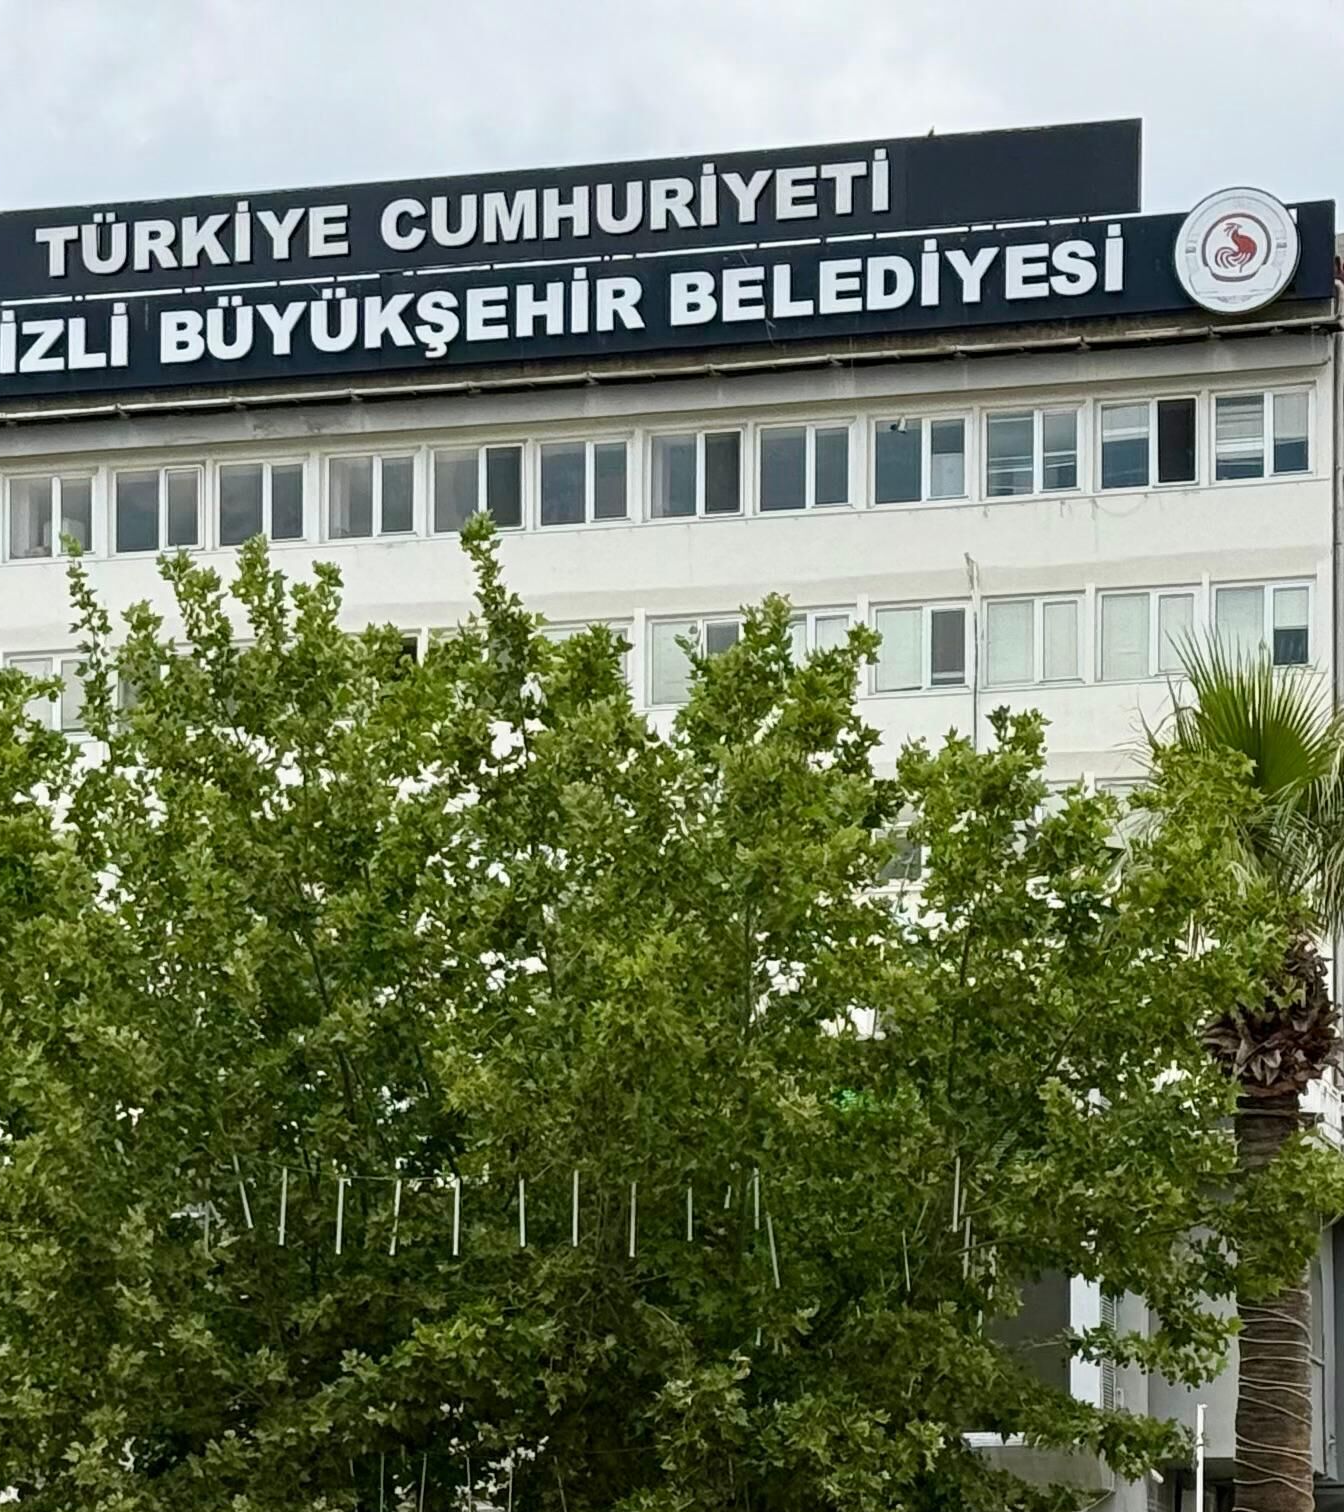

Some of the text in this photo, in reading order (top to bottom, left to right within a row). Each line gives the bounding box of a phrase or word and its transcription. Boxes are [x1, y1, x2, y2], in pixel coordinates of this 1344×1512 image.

[35, 148, 891, 278] TÜRKİYE CUMHURİYETİ
[160, 267, 646, 364] BÜYÜKŞEHİR
[670, 223, 1124, 327] BELEDİYESİ
